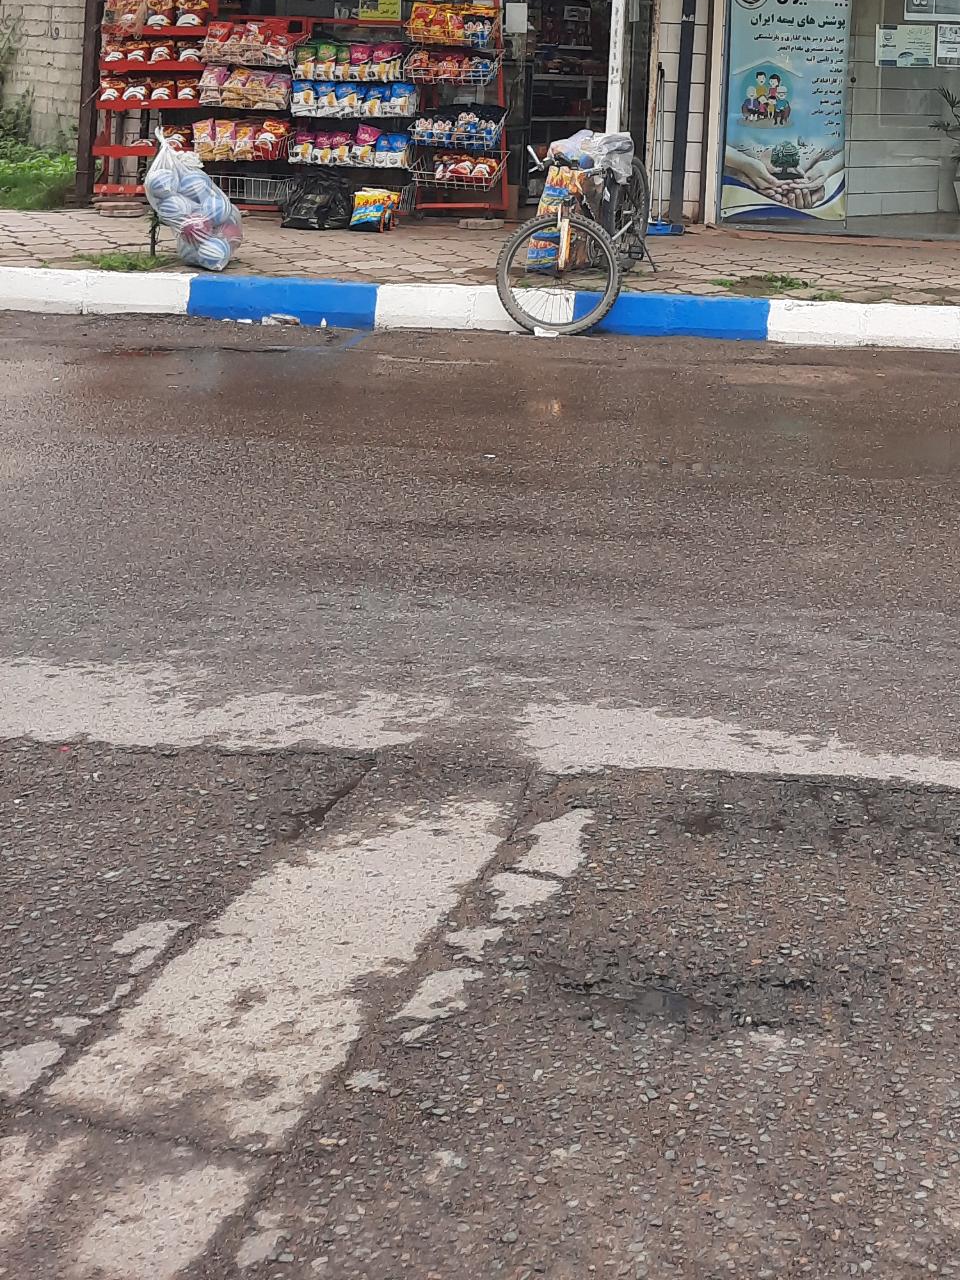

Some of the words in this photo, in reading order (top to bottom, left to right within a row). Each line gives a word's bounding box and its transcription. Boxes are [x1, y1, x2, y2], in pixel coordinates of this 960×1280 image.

[750, 13, 775, 26] ایران
[776, 15, 795, 26] بیمه
[797, 15, 816, 27] های
[818, 16, 846, 30] پوشش
